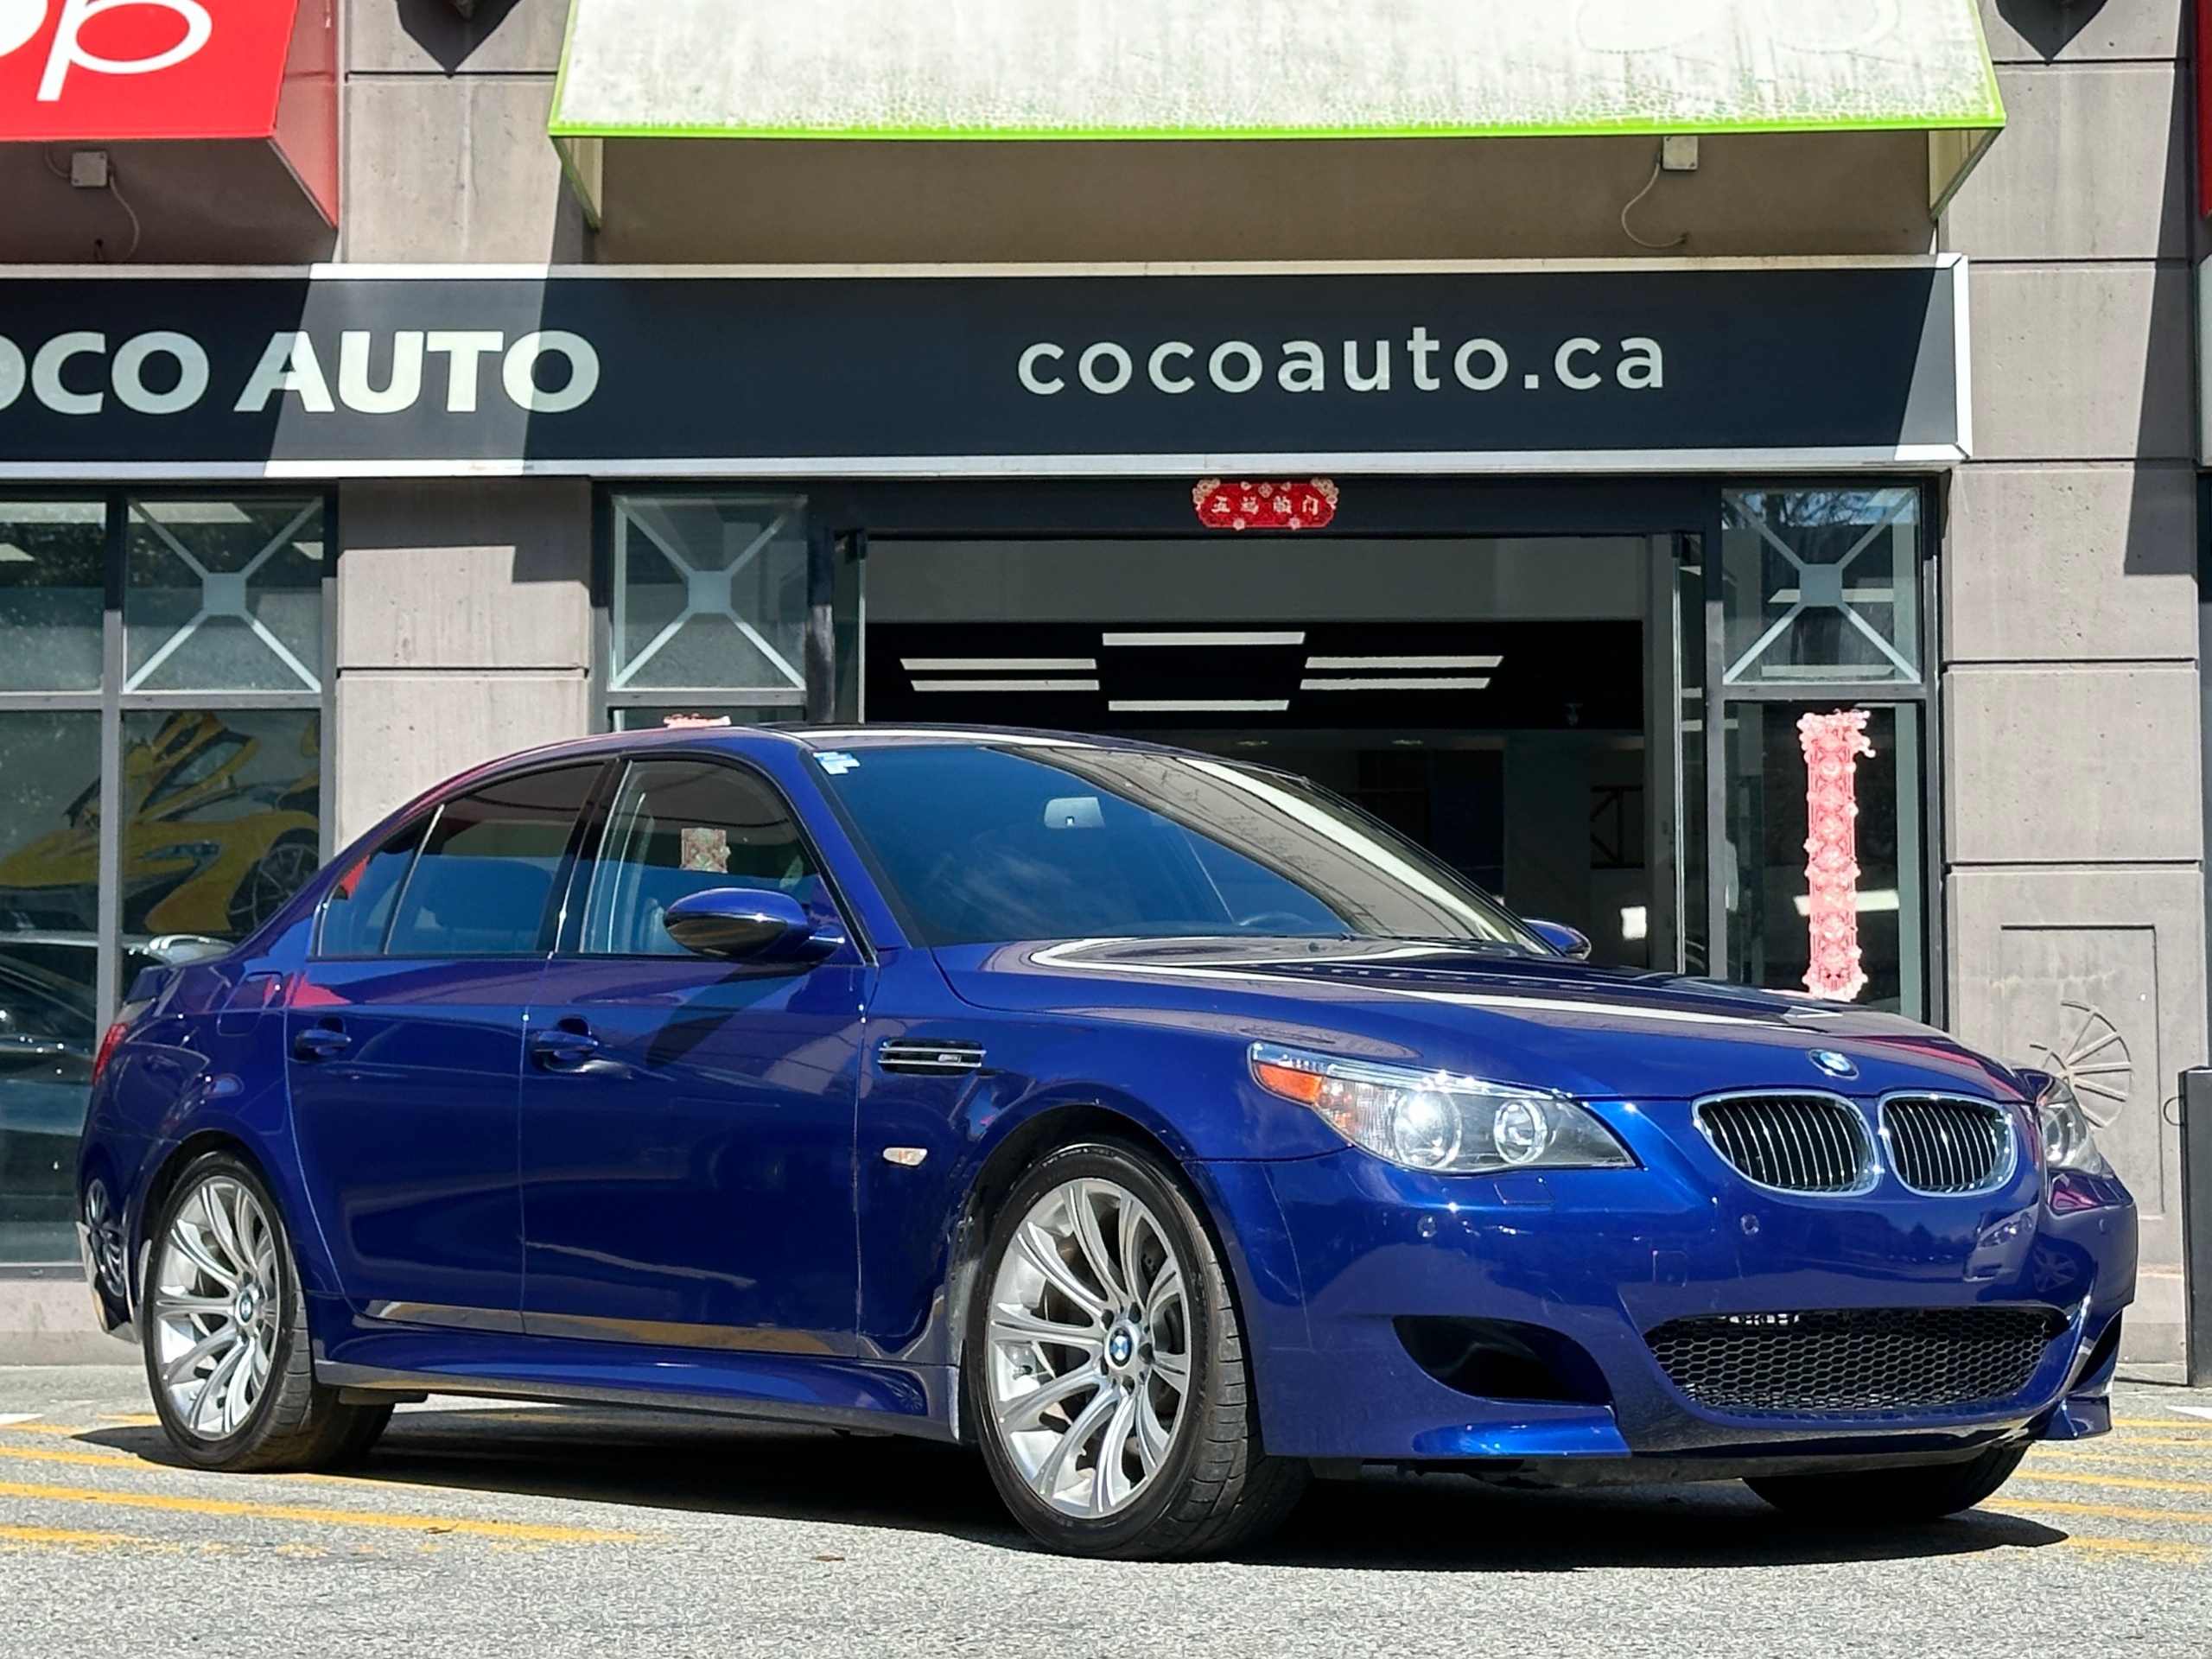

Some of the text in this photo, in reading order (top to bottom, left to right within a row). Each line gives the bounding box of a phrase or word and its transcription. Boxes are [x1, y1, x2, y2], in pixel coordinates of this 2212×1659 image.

[0, 330, 601, 415] CO AUTO
[1017, 326, 1664, 396] cocoauto.ca
